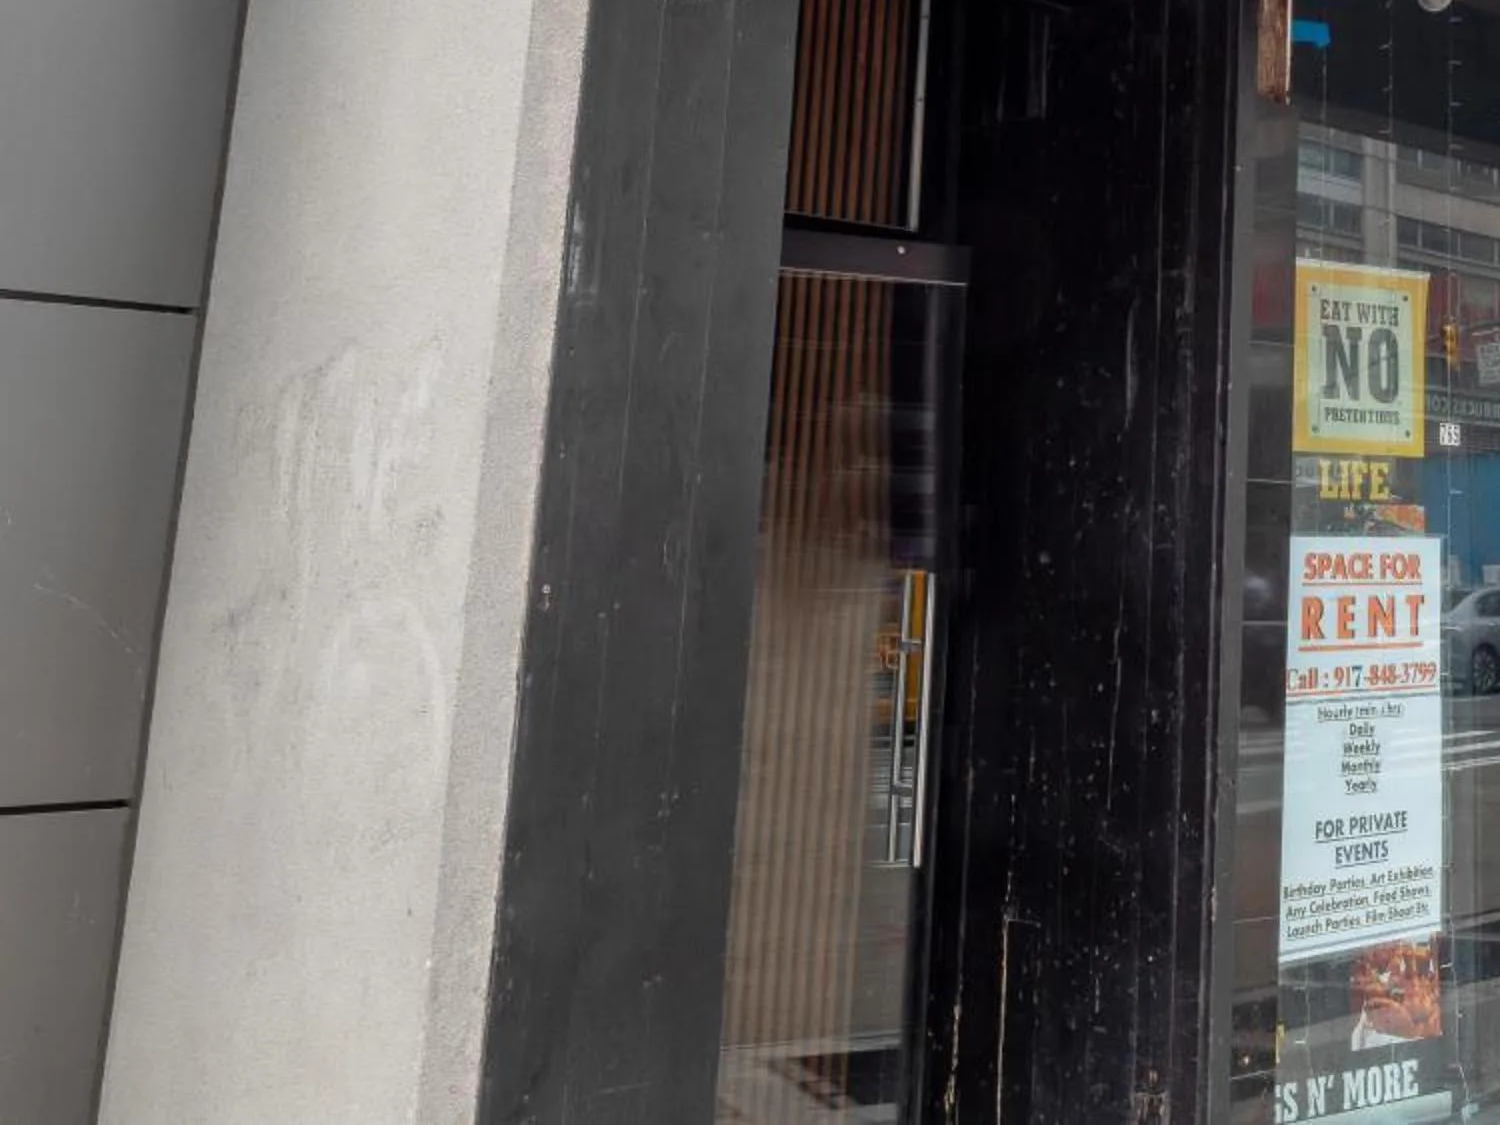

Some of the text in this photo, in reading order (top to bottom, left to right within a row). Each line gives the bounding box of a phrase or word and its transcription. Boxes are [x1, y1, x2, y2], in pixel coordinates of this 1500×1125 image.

[1319, 297, 1400, 327] EAT WITH
[1321, 324, 1400, 404] NO
[1318, 458, 1390, 501] LIFE
[1303, 552, 1422, 580] SPACE FOR
[1301, 594, 1425, 641] RENT
[1287, 666, 1319, 690] Call
[1349, 722, 1376, 737] Daily
[1343, 739, 1381, 756] Weekly
[1341, 758, 1381, 774] Monthly
[1345, 777, 1377, 794] Yearly
[1314, 810, 1409, 840] FOR PRIVATE
[1334, 840, 1390, 866] EVENTS
[1283, 883, 1327, 900] Birthday
[1343, 1058, 1420, 1111] MORE
